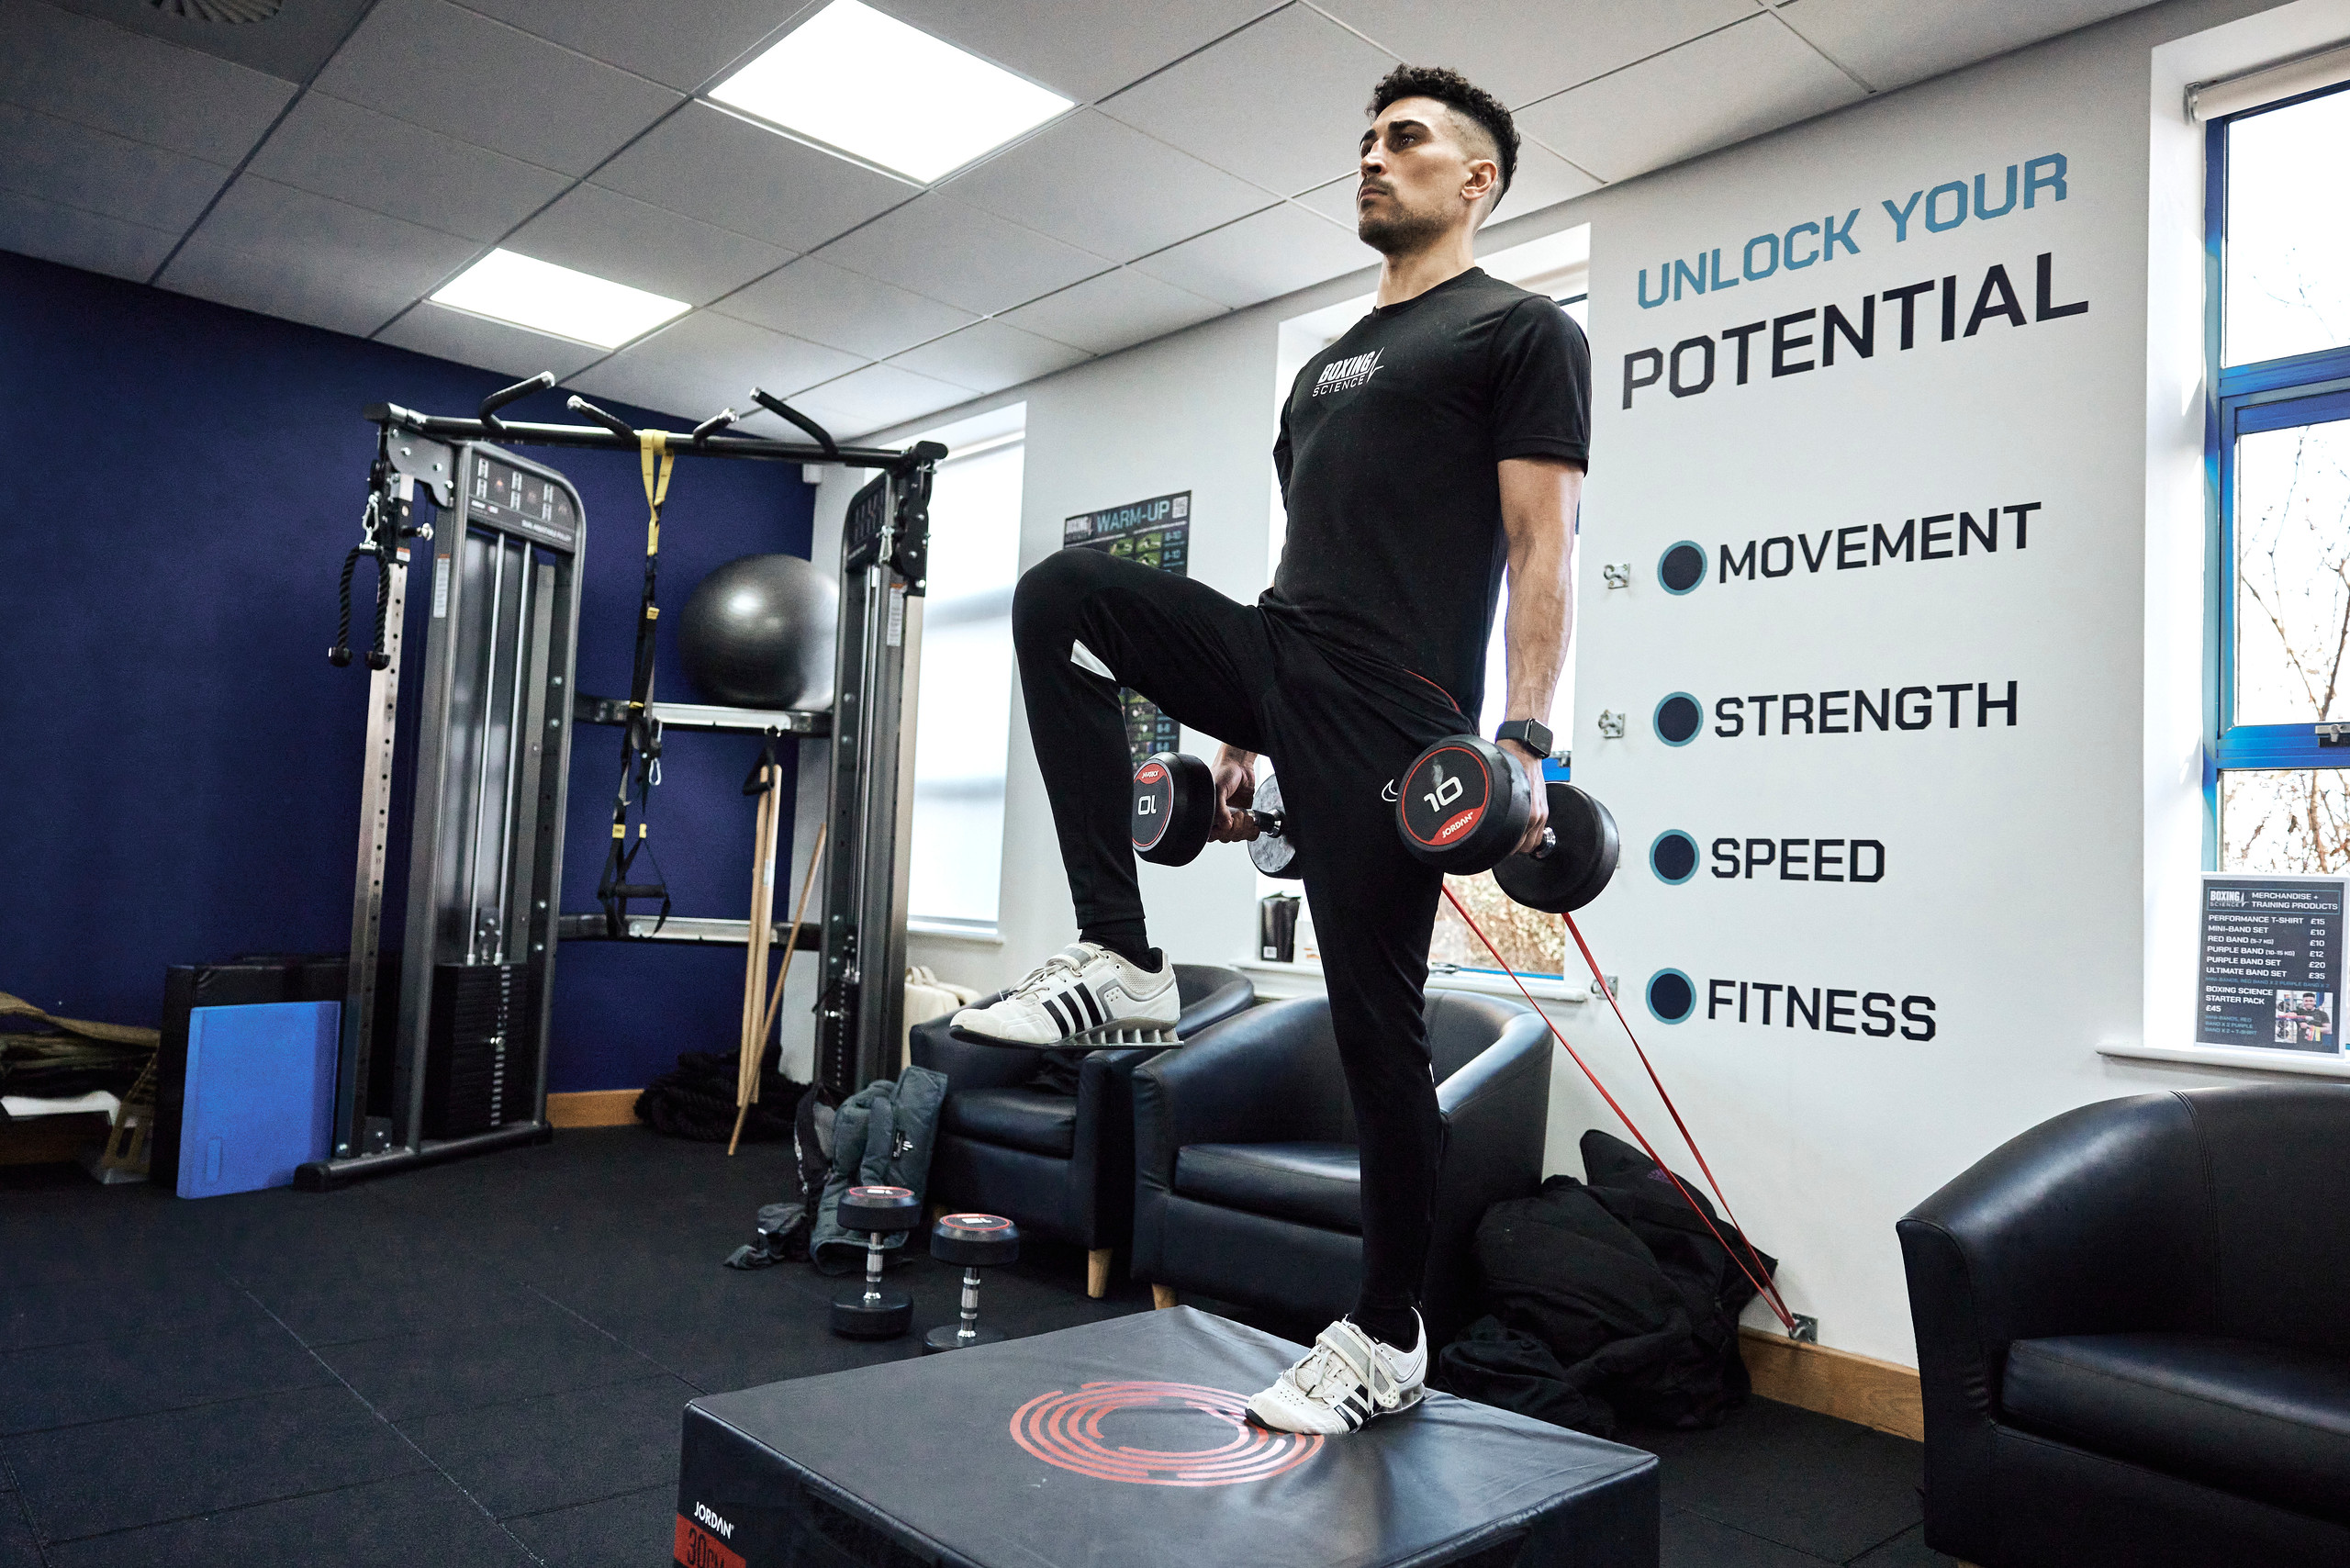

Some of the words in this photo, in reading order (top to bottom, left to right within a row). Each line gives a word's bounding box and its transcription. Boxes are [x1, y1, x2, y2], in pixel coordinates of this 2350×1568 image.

[1637, 208, 1862, 309] UNLOCK
[1882, 152, 2067, 243] YOUR
[1622, 252, 2089, 410] POTENTIAL
[1317, 351, 1376, 384] BOXING
[1312, 375, 1366, 398] SCIENCE
[1096, 499, 1170, 533] WARM-UP
[1718, 501, 2042, 584] MOVEMENT
[1715, 680, 2018, 738] STRENGTH
[1423, 776, 1463, 812] 10
[1138, 795, 1157, 815] 10
[1711, 837, 1886, 883] SPEED
[2210, 890, 2240, 902] BOXING
[2252, 892, 2311, 901] MERCHANDISE
[2252, 901, 2290, 909] TRAINING
[2208, 925, 2252, 934] MINI-BAND
[2209, 914, 2269, 924] PERFORMANCE
[2271, 916, 2304, 924] T-SHIRT
[2207, 946, 2239, 954] PURPLE
[2207, 956, 2239, 964] PURPLE
[2240, 958, 2264, 966] BAND
[2206, 967, 2244, 975] ULTIMATE
[2245, 969, 2269, 977] BAND
[2206, 985, 2236, 994] BOXING
[2238, 987, 2273, 996] SCIENCE
[2206, 994, 2241, 1003] STARTER
[2243, 997, 2265, 1005] PACK
[1707, 979, 1937, 1043] FITNESS
[694, 1501, 732, 1540] JORDAN
